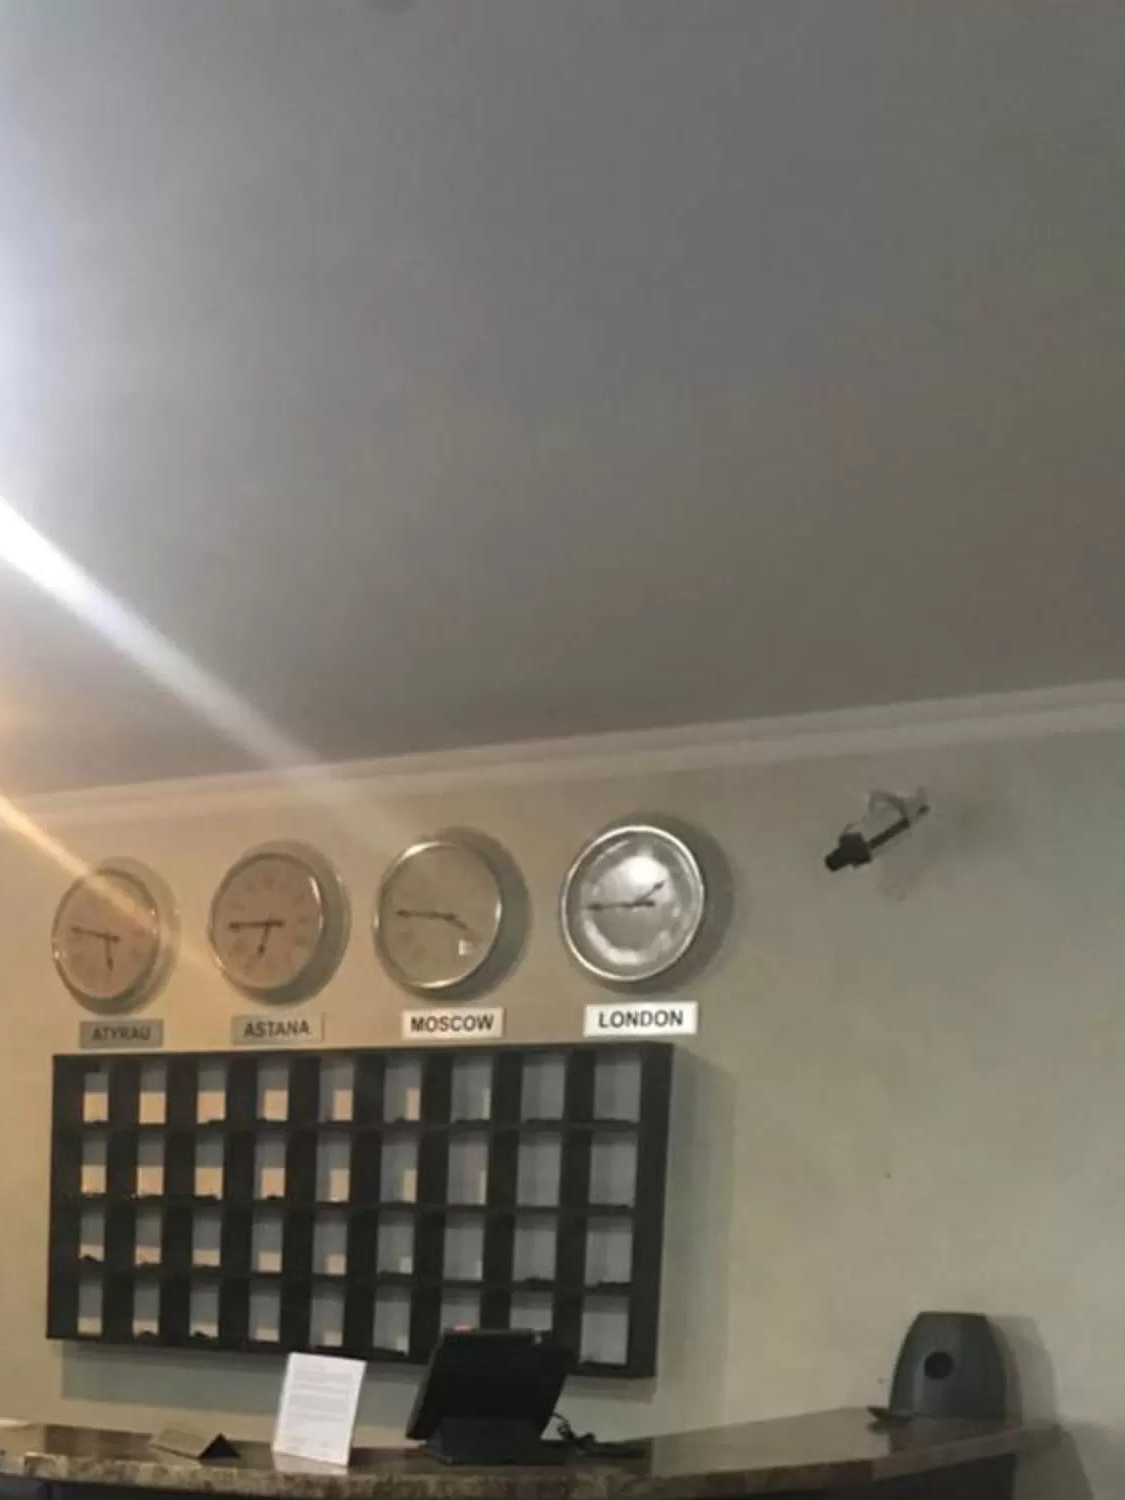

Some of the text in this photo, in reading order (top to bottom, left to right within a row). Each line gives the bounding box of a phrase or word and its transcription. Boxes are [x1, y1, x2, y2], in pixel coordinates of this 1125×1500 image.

[242, 1019, 311, 1038] ASTANA
[411, 1014, 495, 1033] MOSCOW
[598, 1009, 684, 1029] LONDON
[91, 1025, 151, 1041] ATYRAU
